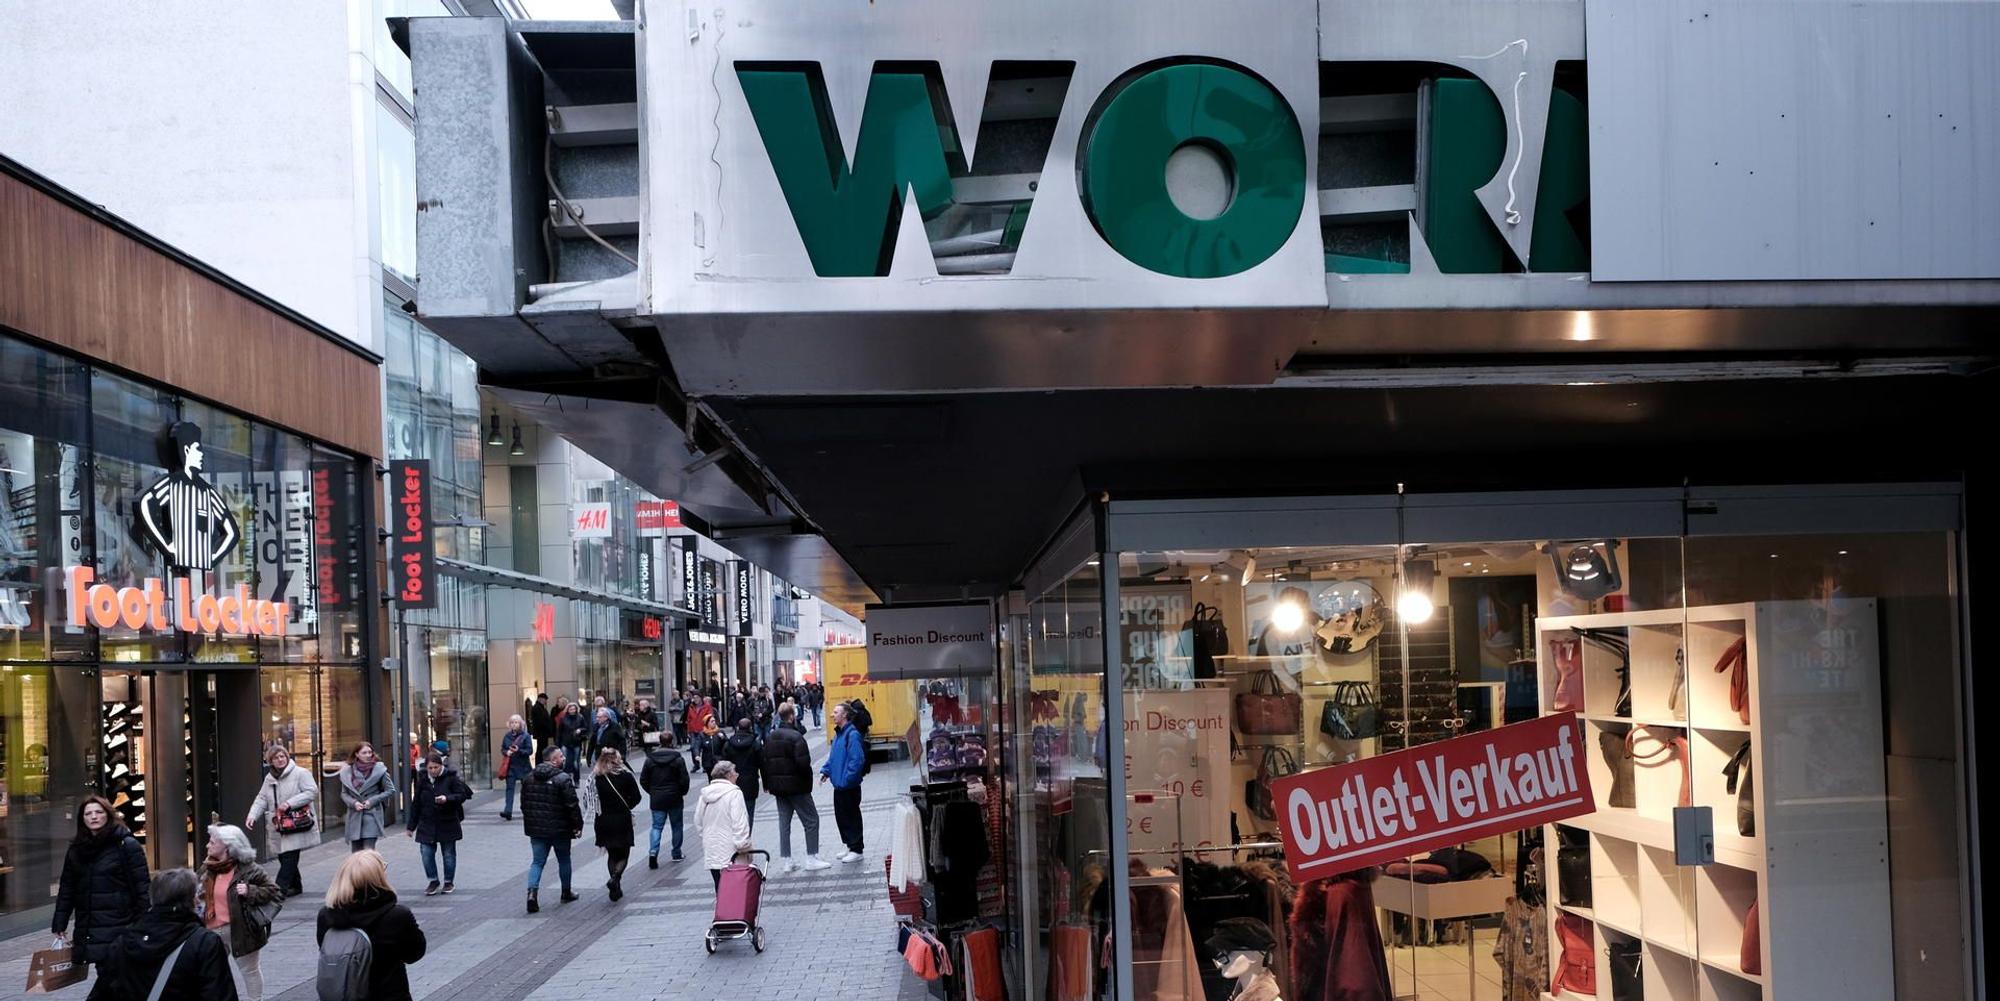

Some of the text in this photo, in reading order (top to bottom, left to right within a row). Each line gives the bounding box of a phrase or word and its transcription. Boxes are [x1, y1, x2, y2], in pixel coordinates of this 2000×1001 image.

[401, 466, 423, 602] Foot Locker
[65, 565, 167, 631] Foot
[173, 576, 289, 635] Locker
[872, 632, 923, 646] Fashion
[927, 630, 984, 644] Discount
[1146, 711, 1224, 731] Discount
[1190, 780, 1204, 798] €
[1288, 725, 1579, 856] Outlet-Verkauf
[1139, 816, 1153, 834] €
